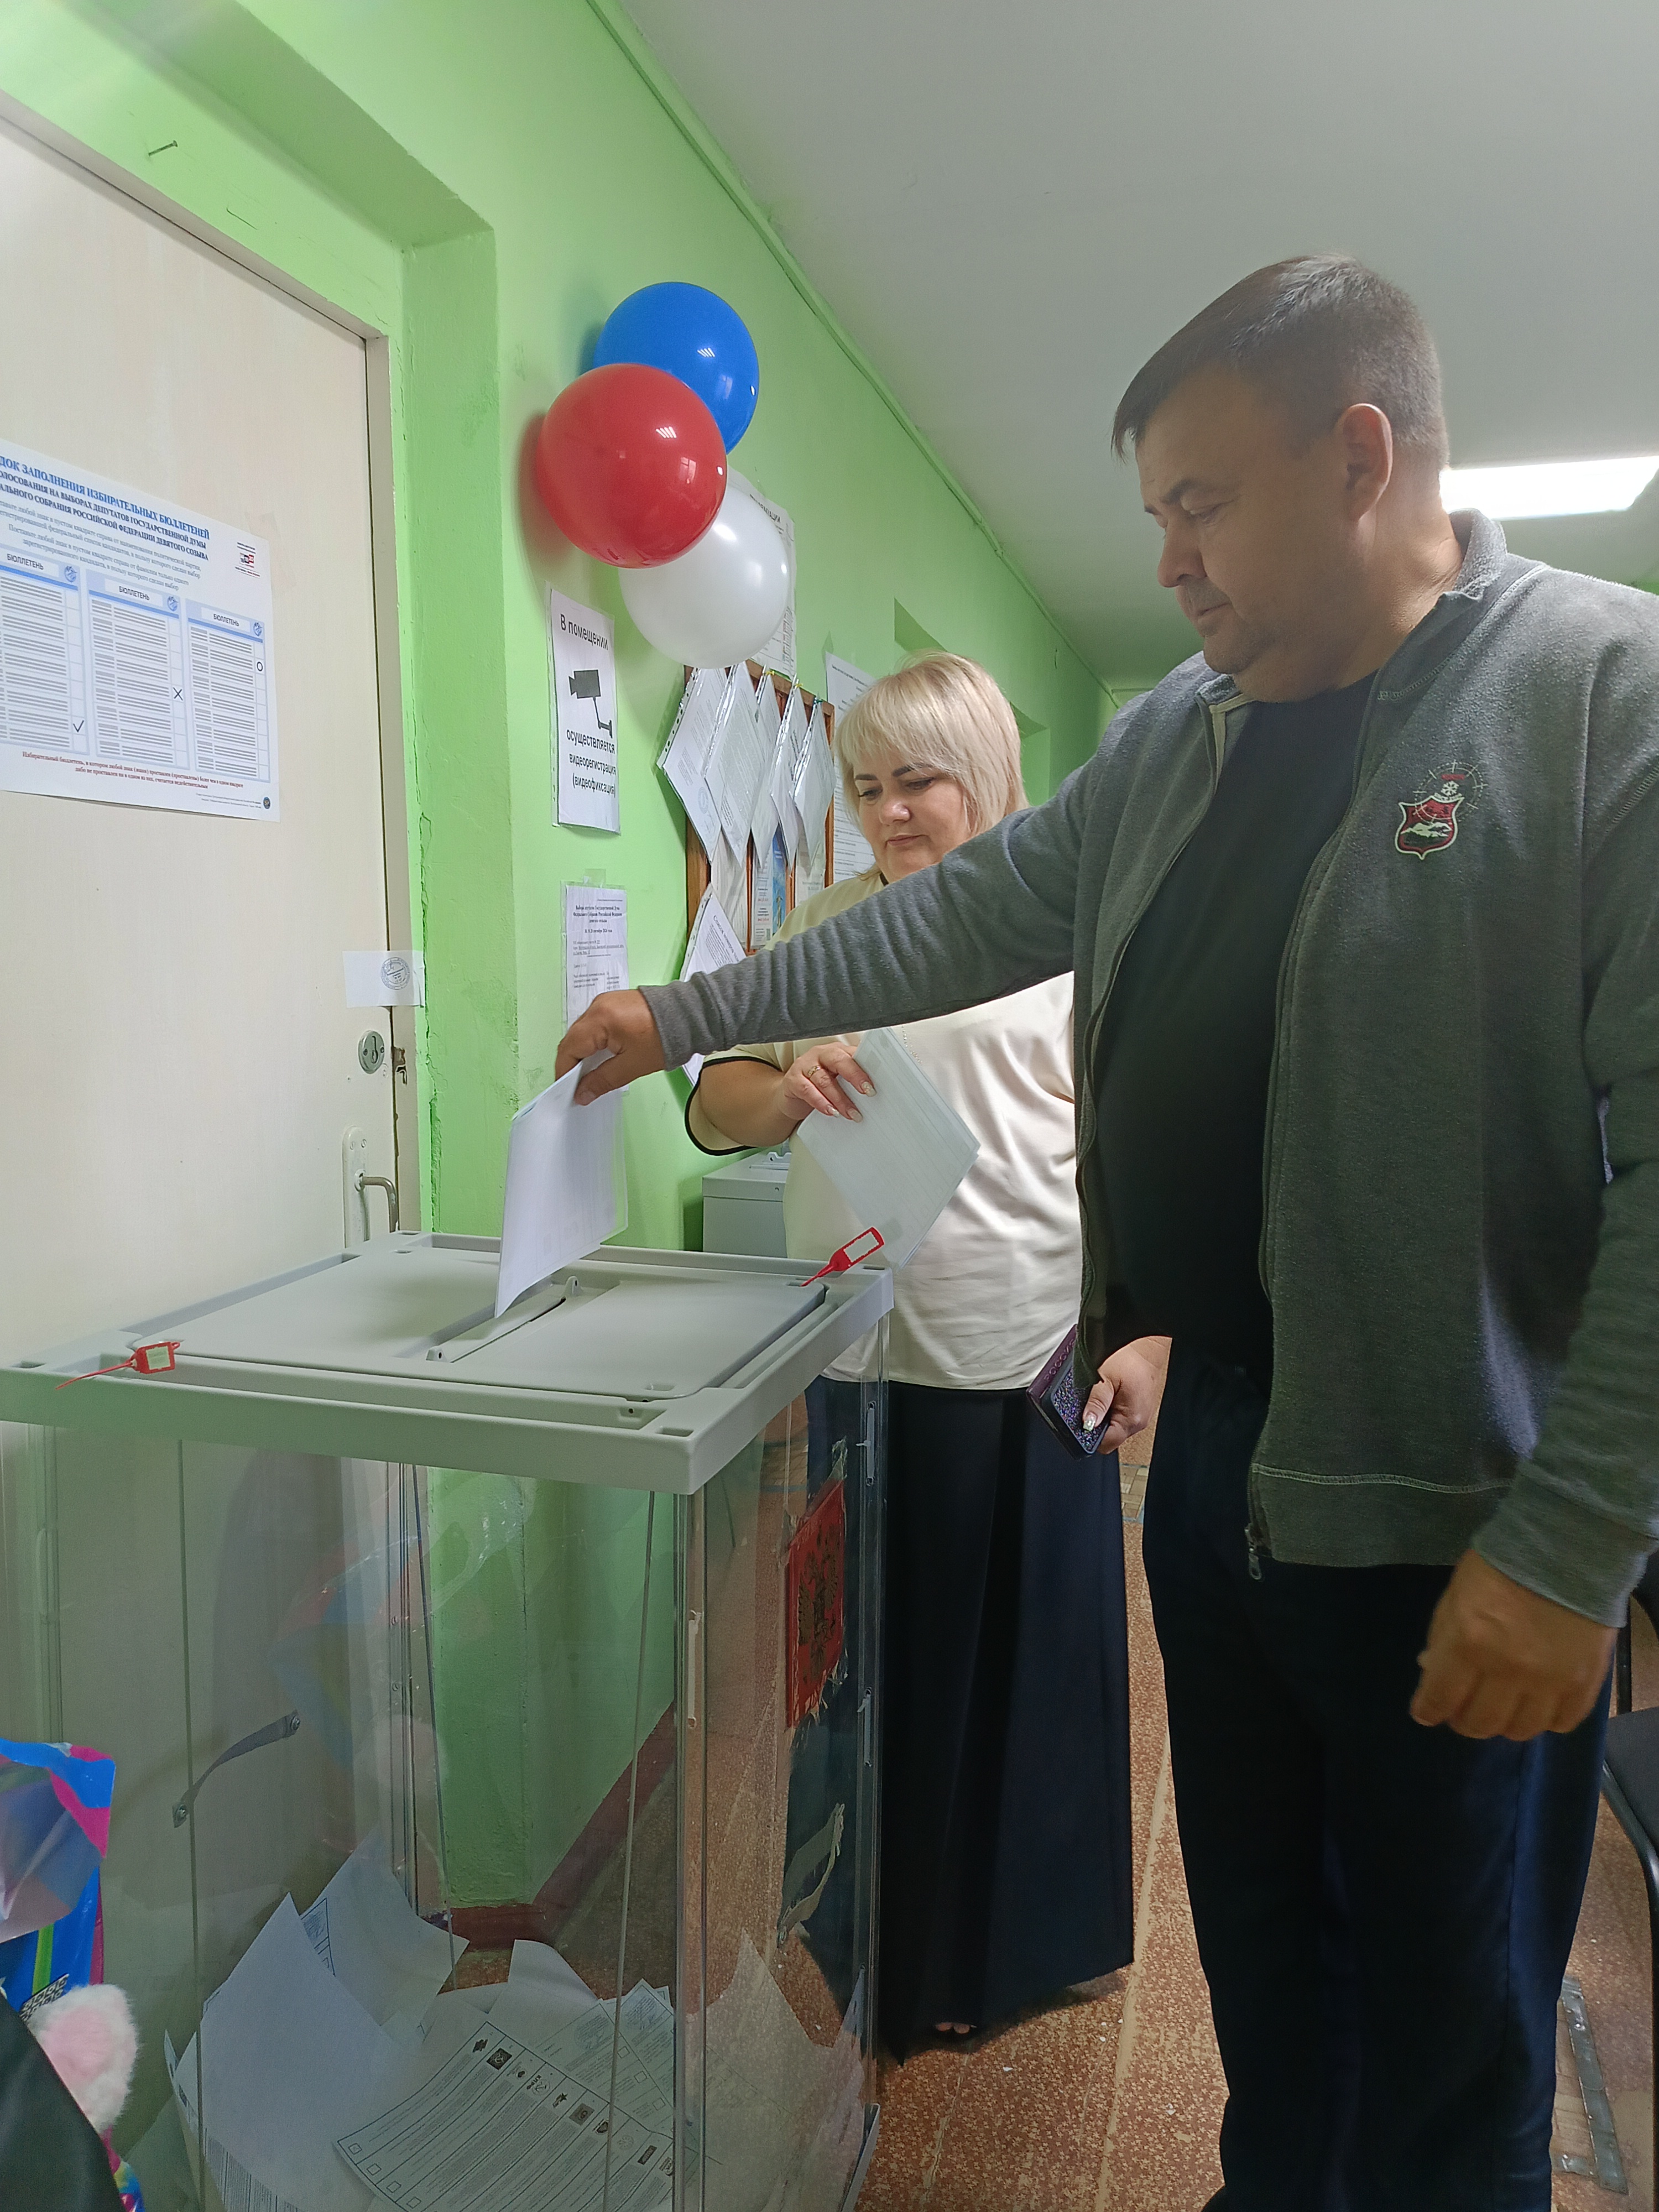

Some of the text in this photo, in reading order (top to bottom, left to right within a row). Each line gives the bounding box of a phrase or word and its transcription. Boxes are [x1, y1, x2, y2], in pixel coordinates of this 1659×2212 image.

[22, 464, 85, 495] ЗАПОЛНЕНИЯ
[87, 487, 158, 521] ИЗБИРАТЕЛЬНЫХ
[159, 514, 210, 540] БЮЛЛЕТЕНЕЙ
[34, 495, 72, 513] СОБРАНИЯ
[72, 508, 118, 530] РОССИЙСКОЙ
[118, 525, 155, 542] ФЕДЕРАЦИИ
[156, 536, 185, 552] ДЕВЯТОГО
[186, 547, 208, 561] СОЗЫВА
[49, 488, 60, 498] НА
[61, 492, 92, 509] ВЫБОРАХ
[93, 503, 129, 521] ДЕПУТАТОВ
[130, 517, 189, 542] ГОСУДАРСТВЕННОЙ
[190, 538, 206, 549] ДУМЫ
[7, 554, 44, 570] БЮЛЛЕТЕНЬ
[118, 586, 150, 601] БЮЛЛЕТЕНЬ
[213, 613, 239, 627] БЮЛЛЕТЕНЬ
[560, 613, 608, 650] В помещении
[566, 728, 615, 755] осуществляется
[569, 753, 616, 776] видеорегистрация
[572, 773, 616, 797] (видеофиксация)
